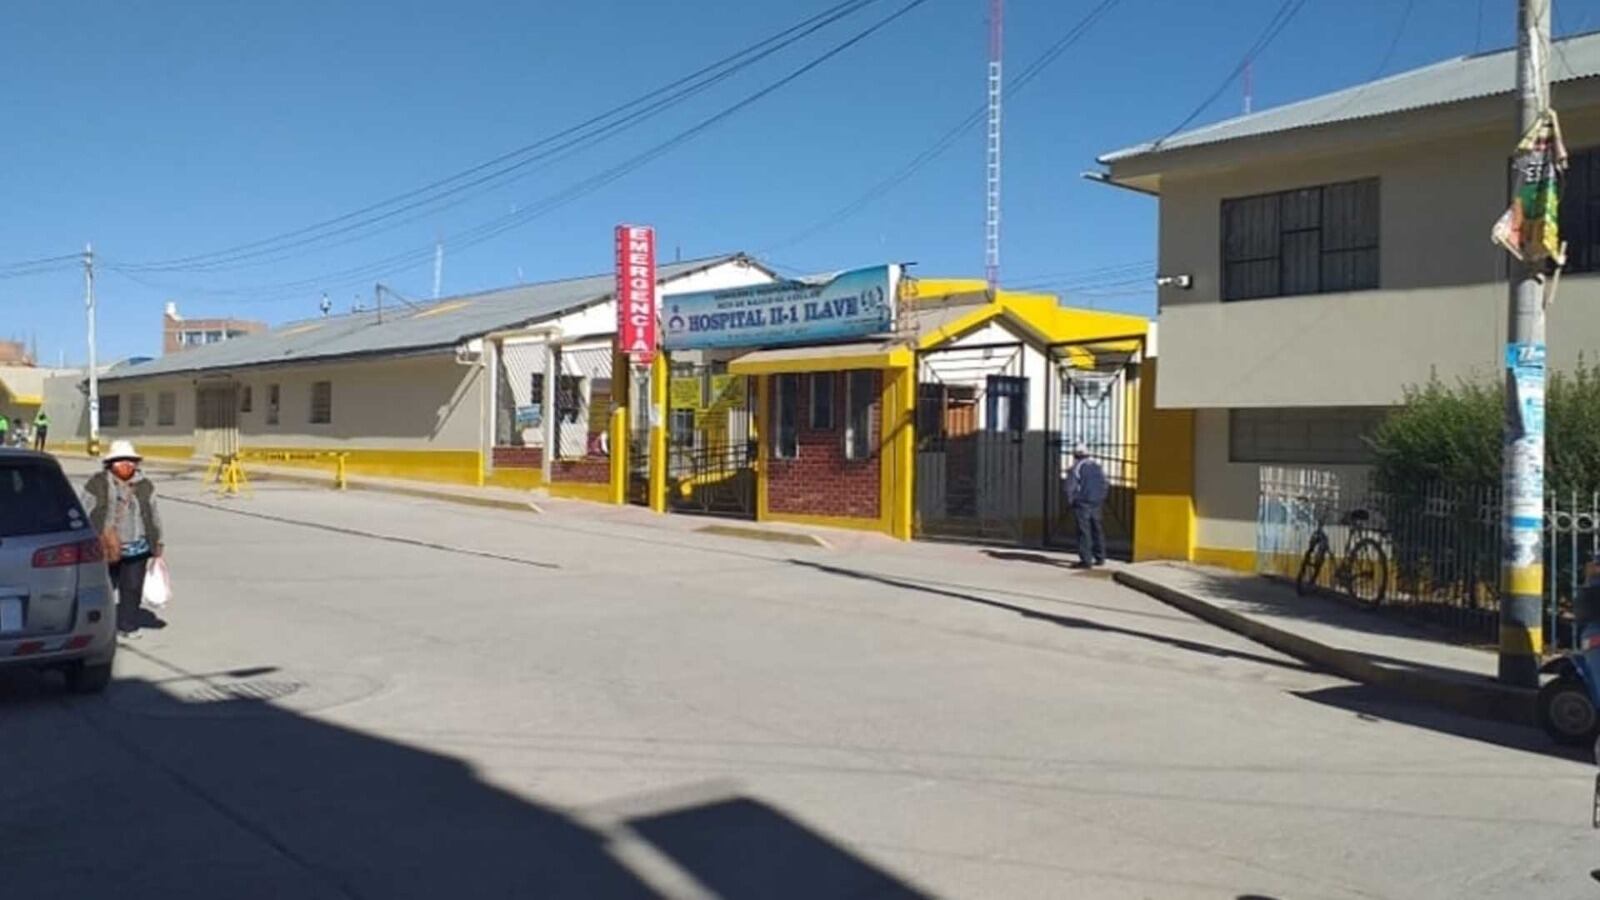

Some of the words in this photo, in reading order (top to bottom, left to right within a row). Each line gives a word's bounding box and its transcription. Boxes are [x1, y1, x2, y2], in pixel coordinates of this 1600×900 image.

[629, 227, 650, 352] EMERGENCIA
[688, 309, 766, 331] HOSPITAL
[770, 305, 799, 325] II-1
[804, 296, 858, 321] ILAVE
